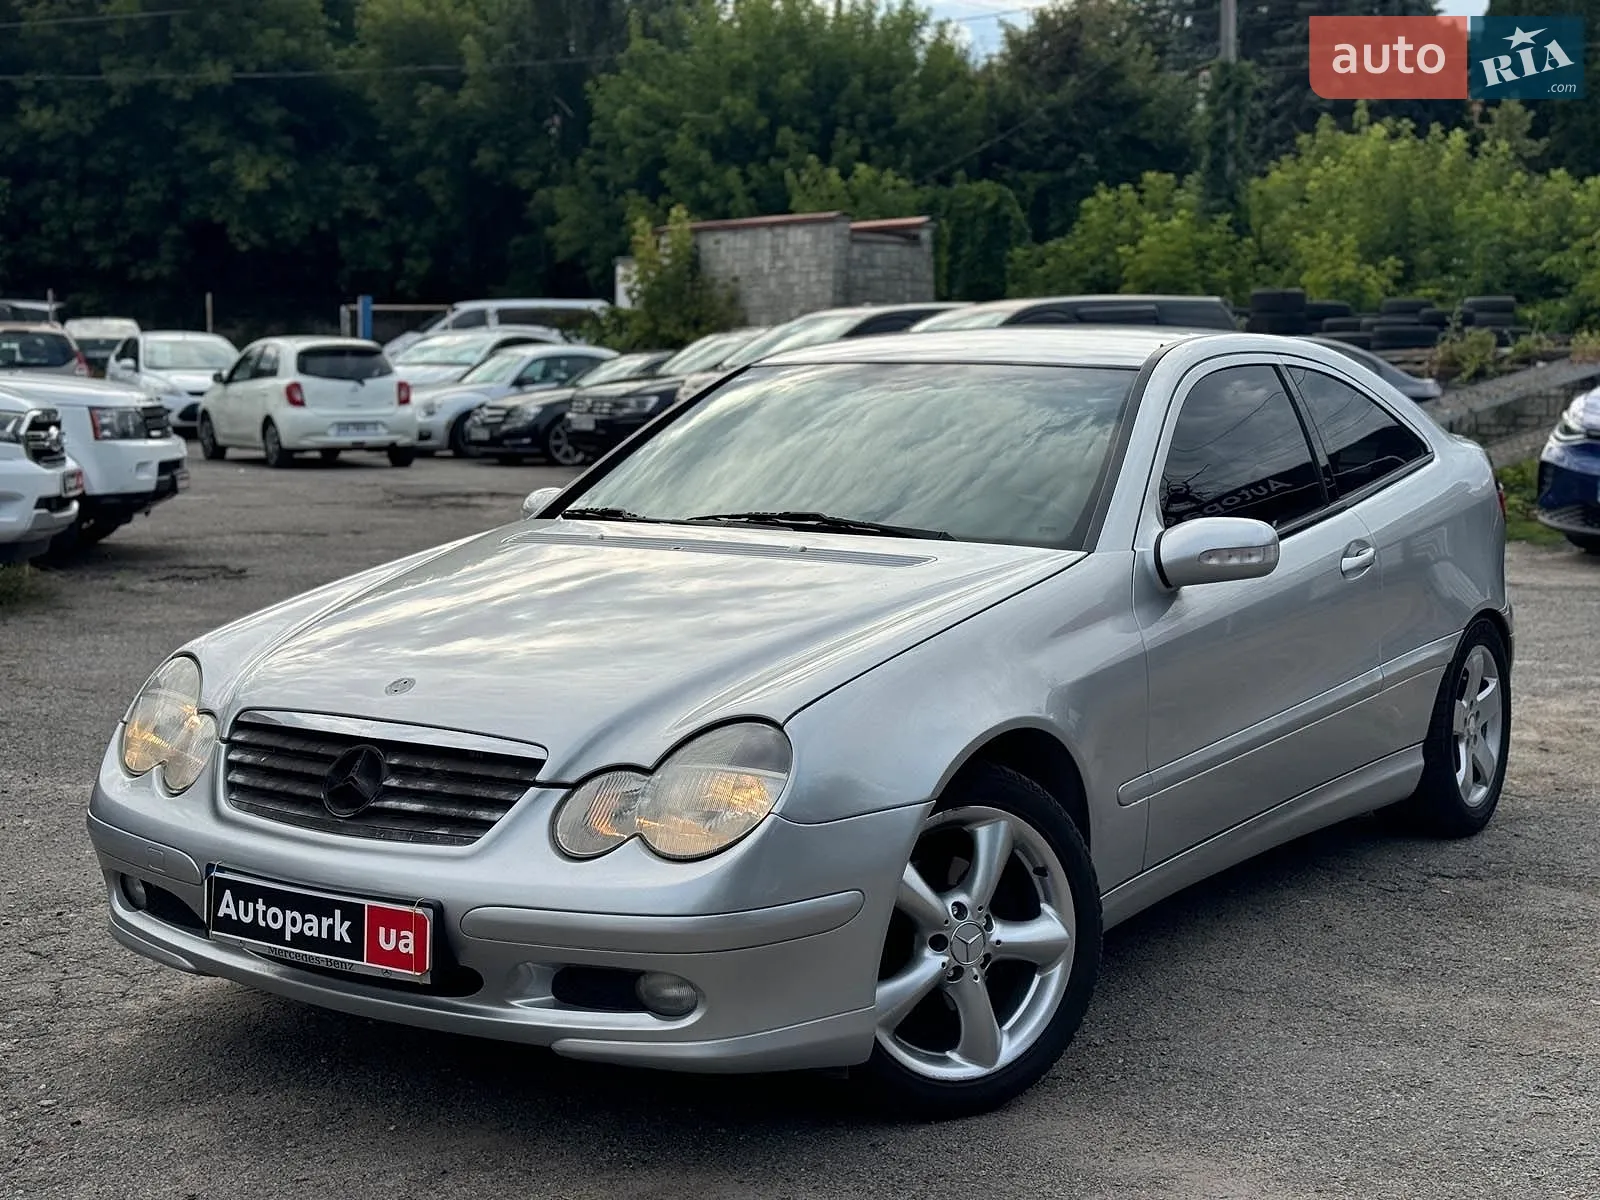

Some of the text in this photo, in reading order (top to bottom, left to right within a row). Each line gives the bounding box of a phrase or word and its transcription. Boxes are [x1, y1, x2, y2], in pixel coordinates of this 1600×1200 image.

[217, 889, 415, 954] Autopark ua
[267, 946, 354, 971] Mercedes-Benz
